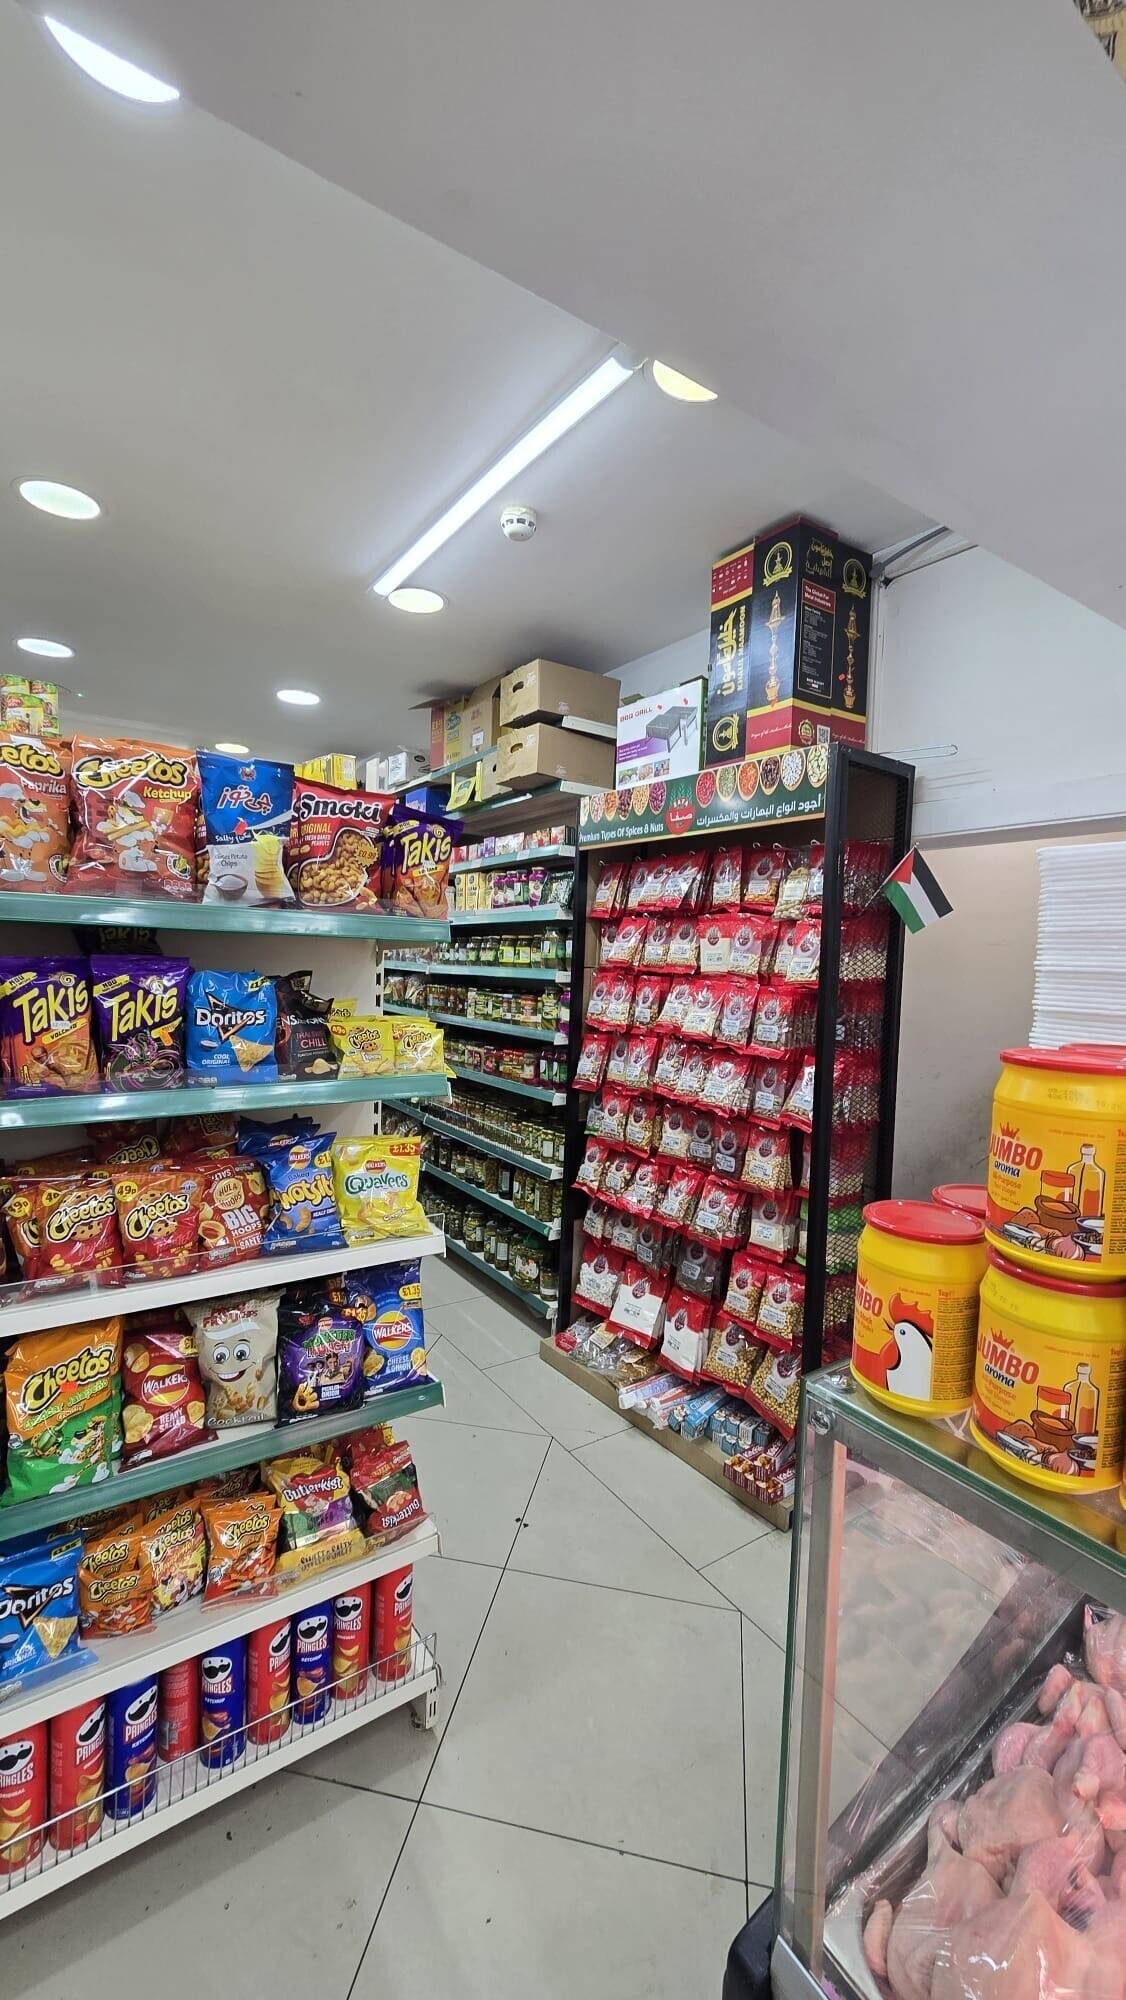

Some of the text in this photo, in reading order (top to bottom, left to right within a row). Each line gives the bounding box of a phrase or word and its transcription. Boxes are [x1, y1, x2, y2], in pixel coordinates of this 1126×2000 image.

[0, 744, 64, 777] etos
[77, 756, 188, 790] Cheetos
[143, 785, 192, 800] Ketchup
[300, 793, 381, 823] Smoki
[626, 825, 644, 838] Spices
[650, 822, 664, 834] Nuts
[400, 832, 452, 874] Takis
[12, 980, 89, 1043] Takis
[103, 986, 178, 1042] Takis
[196, 1007, 266, 1027] Doritos
[348, 1028, 381, 1049] Cheetos
[287, 1171, 310, 1182] Baked
[993, 1160, 1021, 1178] aroma
[116, 1185, 137, 1196] 49p
[219, 1182, 238, 1196] HULA
[344, 1172, 409, 1195] Quavers
[47, 1195, 116, 1241] Cheetos
[126, 1193, 189, 1240] Cheetos
[221, 1204, 260, 1230] BIG
[231, 1220, 262, 1237] HOOPS
[401, 1284, 421, 1298] £1.35
[373, 1321, 413, 1340] WALKERS
[386, 1354, 411, 1367] CHEESE
[391, 1362, 412, 1374] ONION
[24, 1348, 112, 1410] Cheetos
[984, 1363, 1016, 1389] aroma
[320, 1388, 340, 1399] ONION
[158, 1415, 186, 1433] SALTED
[159, 1407, 183, 1424] READY
[283, 1476, 344, 1502] Butterkist
[381, 1498, 421, 1528] Butterkist
[224, 1513, 270, 1548] Cheetos
[149, 1527, 195, 1563] Cheetos
[88, 1575, 138, 1600] Cheetos
[333, 1615, 362, 1631] PRINGLES
[296, 1632, 328, 1653] PRINGLES
